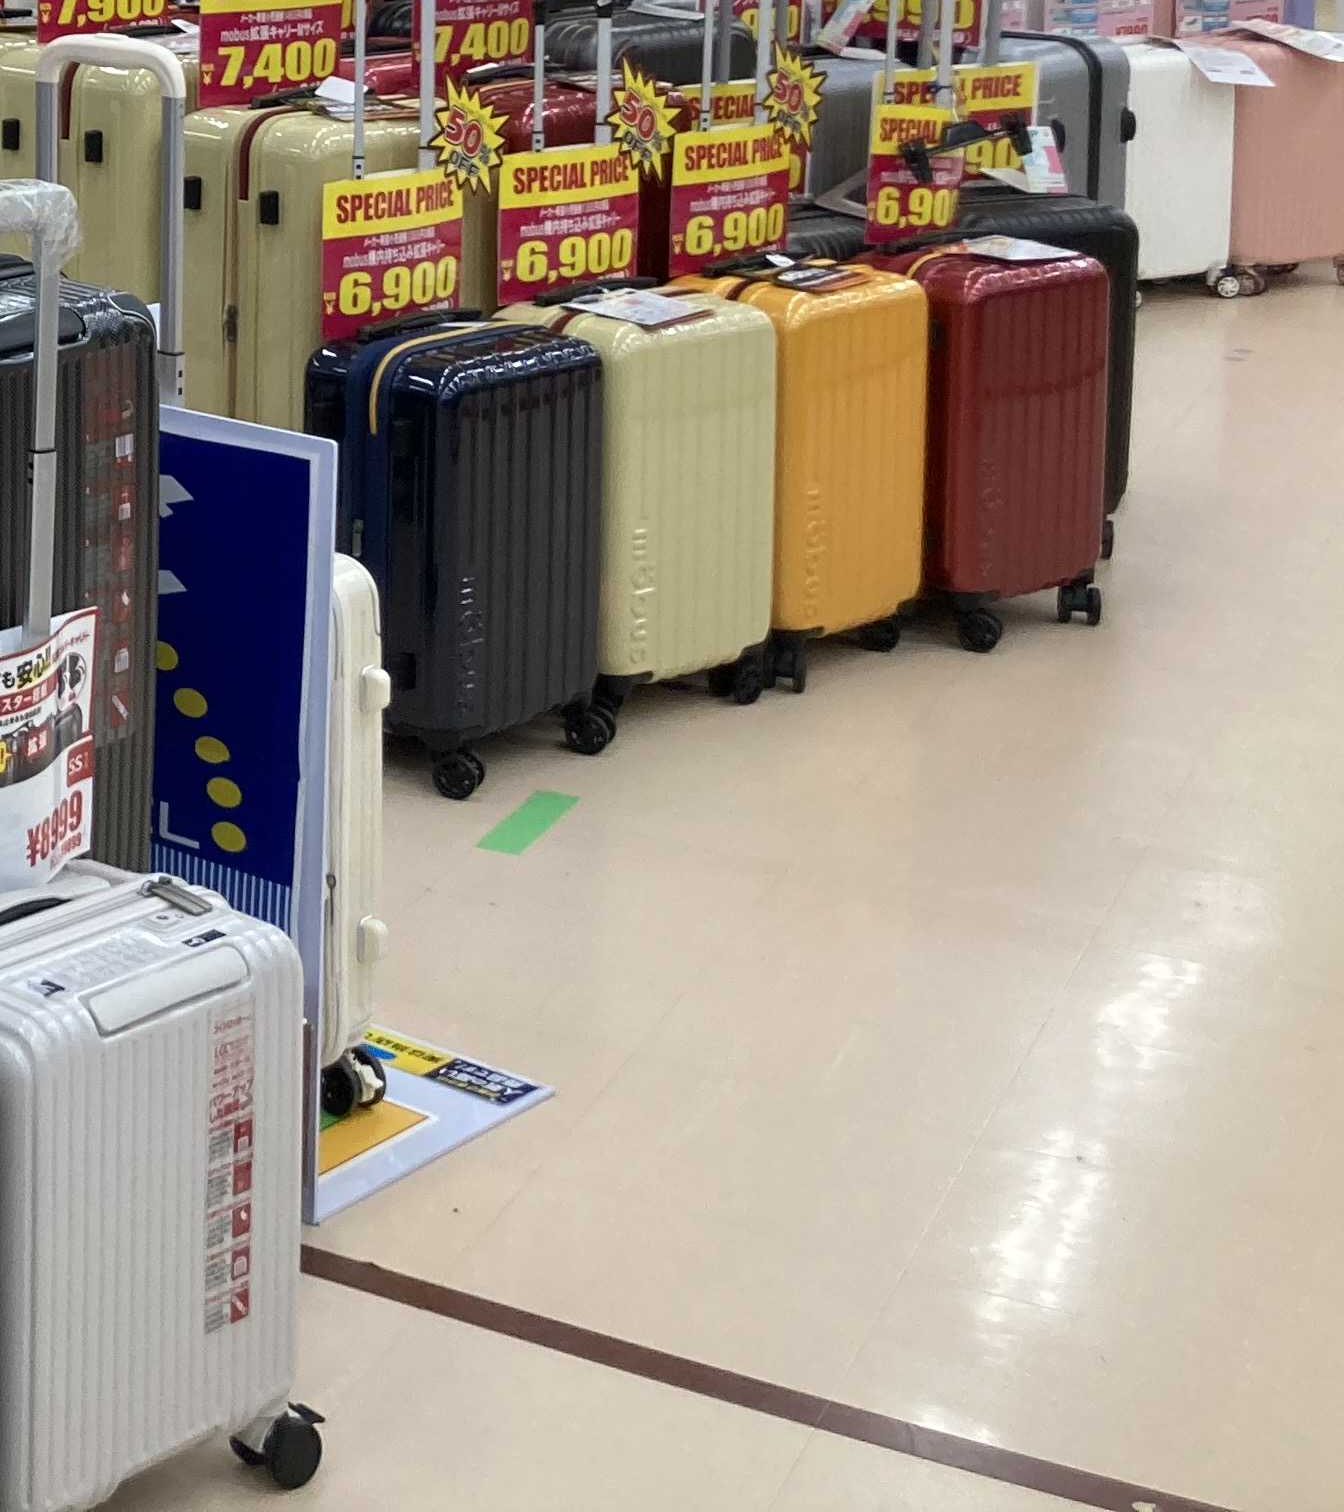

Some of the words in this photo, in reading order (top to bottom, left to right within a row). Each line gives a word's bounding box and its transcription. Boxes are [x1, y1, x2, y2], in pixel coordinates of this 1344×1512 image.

[434, 18, 530, 62] 7,400
[217, 38, 338, 88] 7,400
[971, 73, 1023, 99] PRICE
[684, 140, 748, 171] SPECIAL
[752, 132, 785, 163] PRICE
[513, 162, 581, 194] SPECIAL
[584, 156, 631, 188] PRICE
[336, 189, 411, 224] SPECIAL
[416, 180, 454, 213] PRICE
[684, 203, 784, 257] 6,900
[339, 255, 457, 316] 6,900
[517, 246, 633, 285] 6,900
